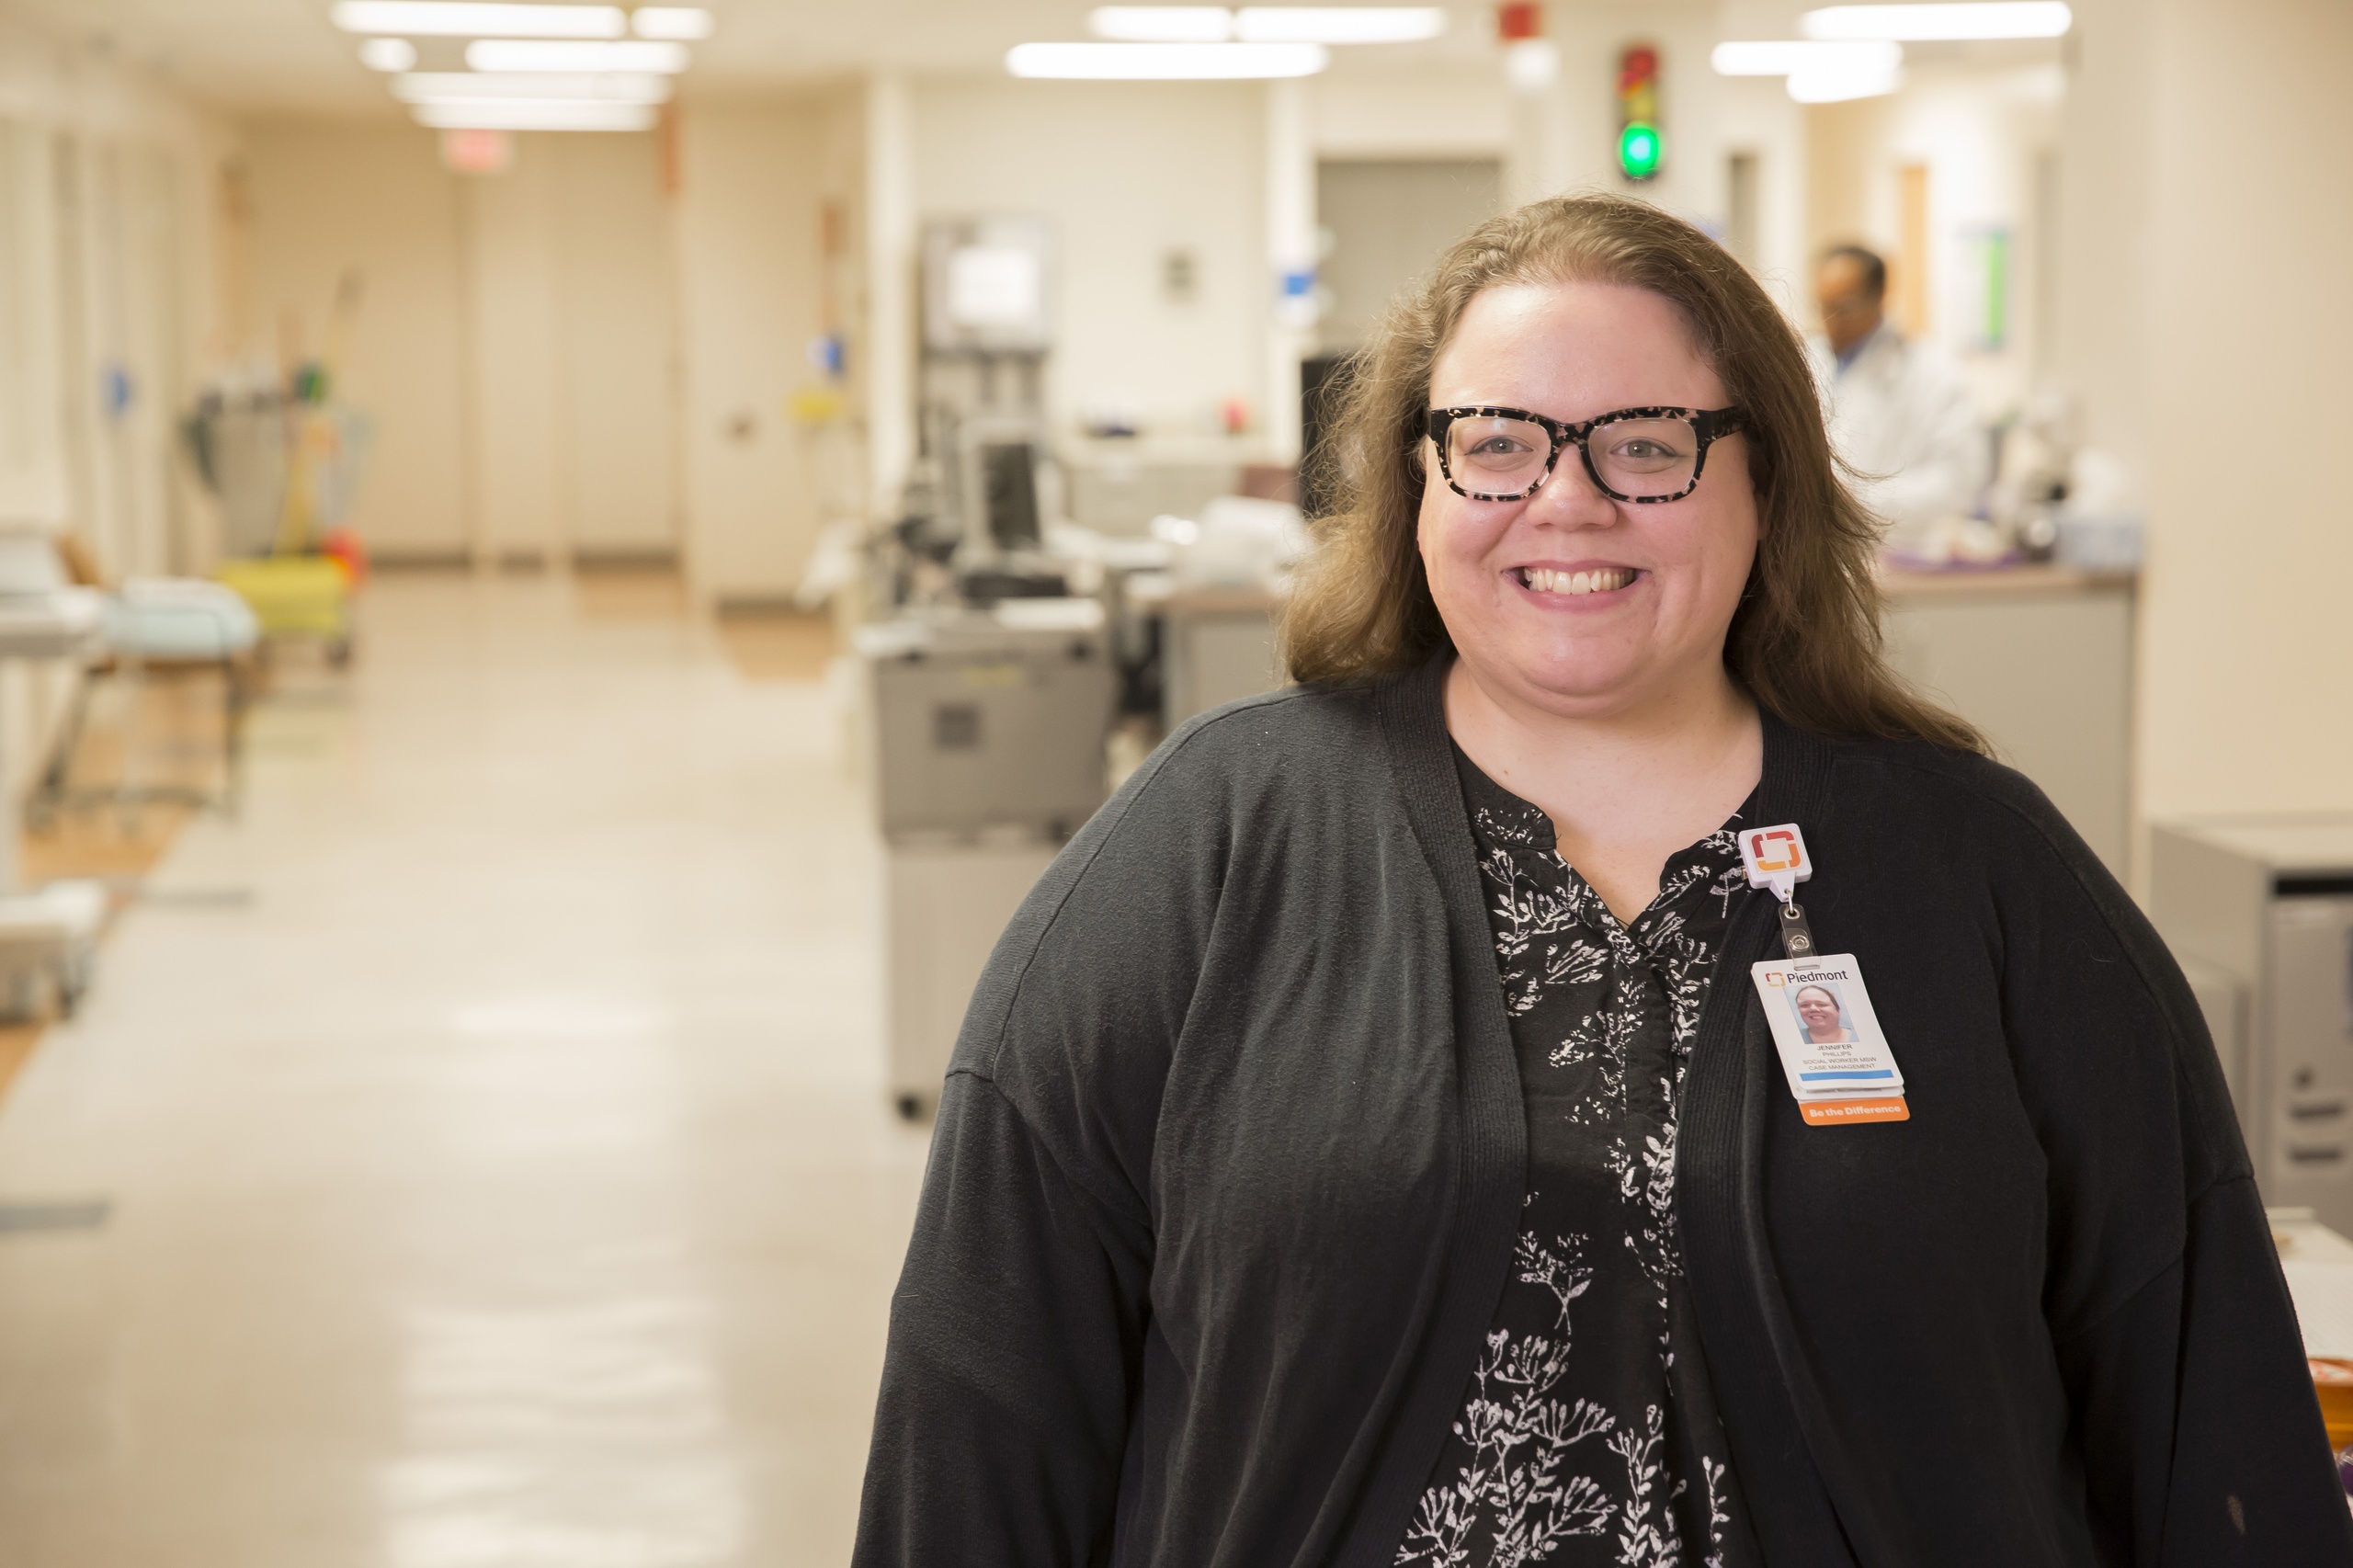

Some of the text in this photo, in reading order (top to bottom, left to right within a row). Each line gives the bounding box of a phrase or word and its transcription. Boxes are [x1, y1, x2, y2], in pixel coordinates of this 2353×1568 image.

[1786, 970, 1848, 983] Piedmont
[1809, 1106, 1902, 1118] Be the Difference
